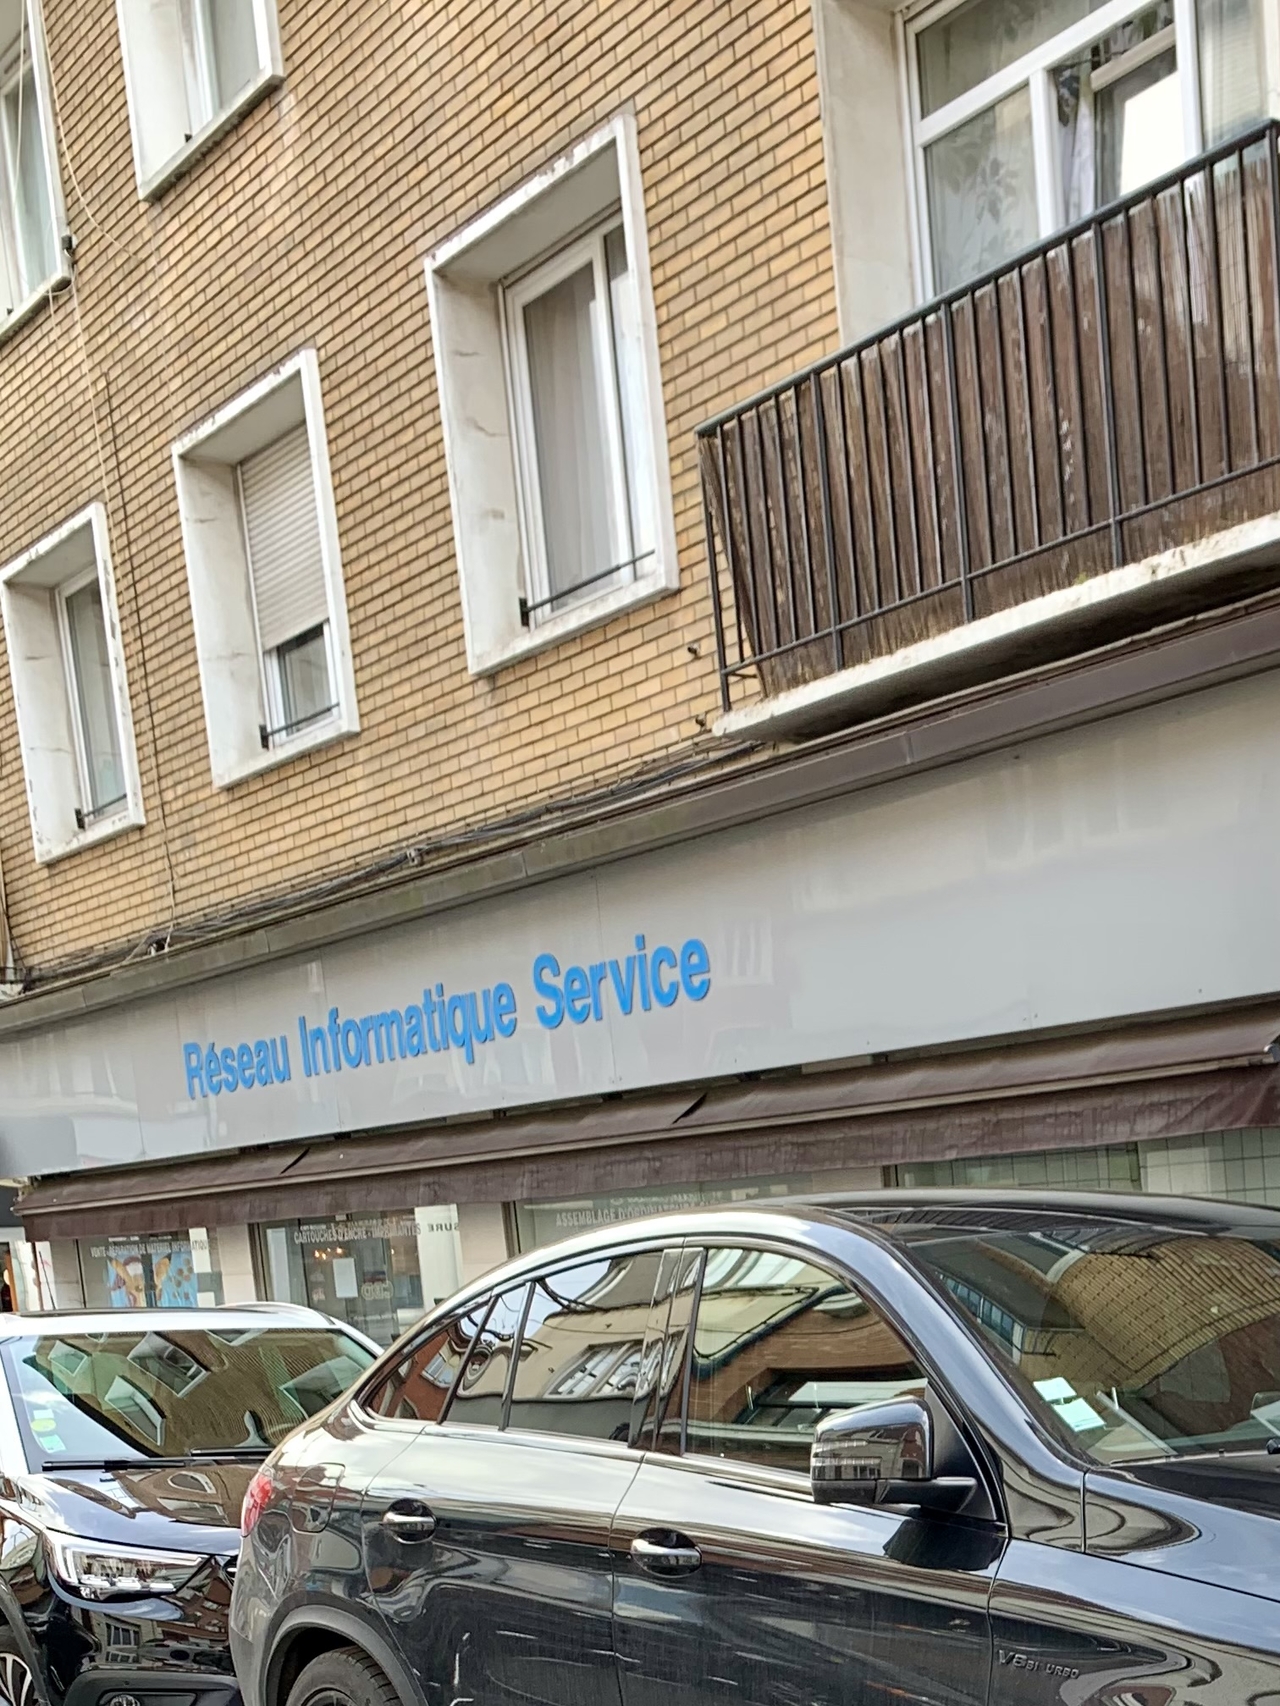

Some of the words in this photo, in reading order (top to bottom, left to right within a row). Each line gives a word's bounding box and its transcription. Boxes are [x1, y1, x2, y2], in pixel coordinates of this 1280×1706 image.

[183, 1035, 292, 1101] Réseau
[298, 982, 518, 1078] Informatique
[532, 934, 711, 1030] Service
[556, 1208, 616, 1227] ASSEMBLAGE
[293, 1224, 338, 1245] CARTOUCHES
[999, 1649, 1027, 1668] V8
